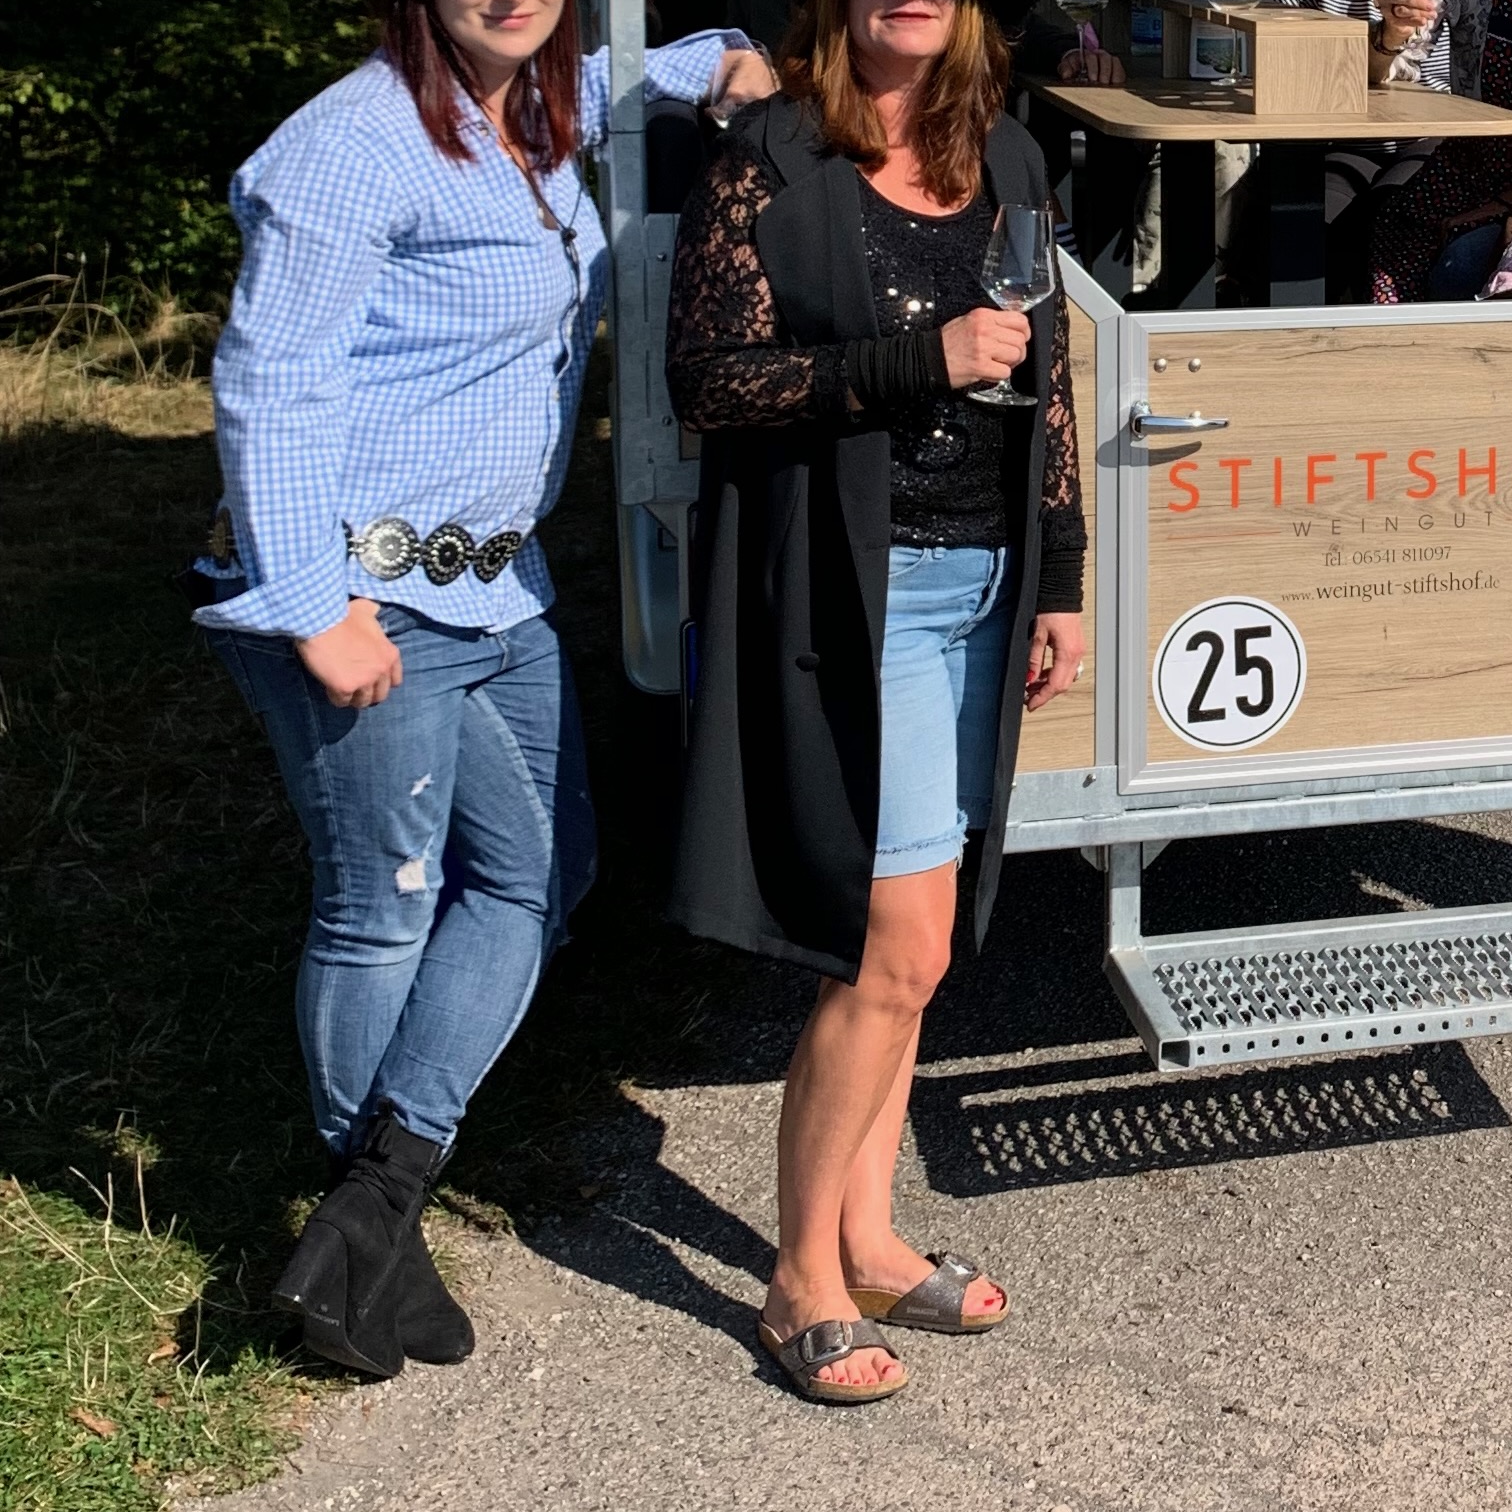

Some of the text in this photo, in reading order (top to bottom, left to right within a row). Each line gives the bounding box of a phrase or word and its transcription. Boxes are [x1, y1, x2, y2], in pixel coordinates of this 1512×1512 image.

[1292, 511, 1495, 537] WEINGUT
[1352, 549, 1396, 565] 06541
[1402, 546, 1452, 562] 811097
[1281, 570, 1500, 603] www.weingut-stiftshof.de
[1185, 625, 1274, 724] 25
